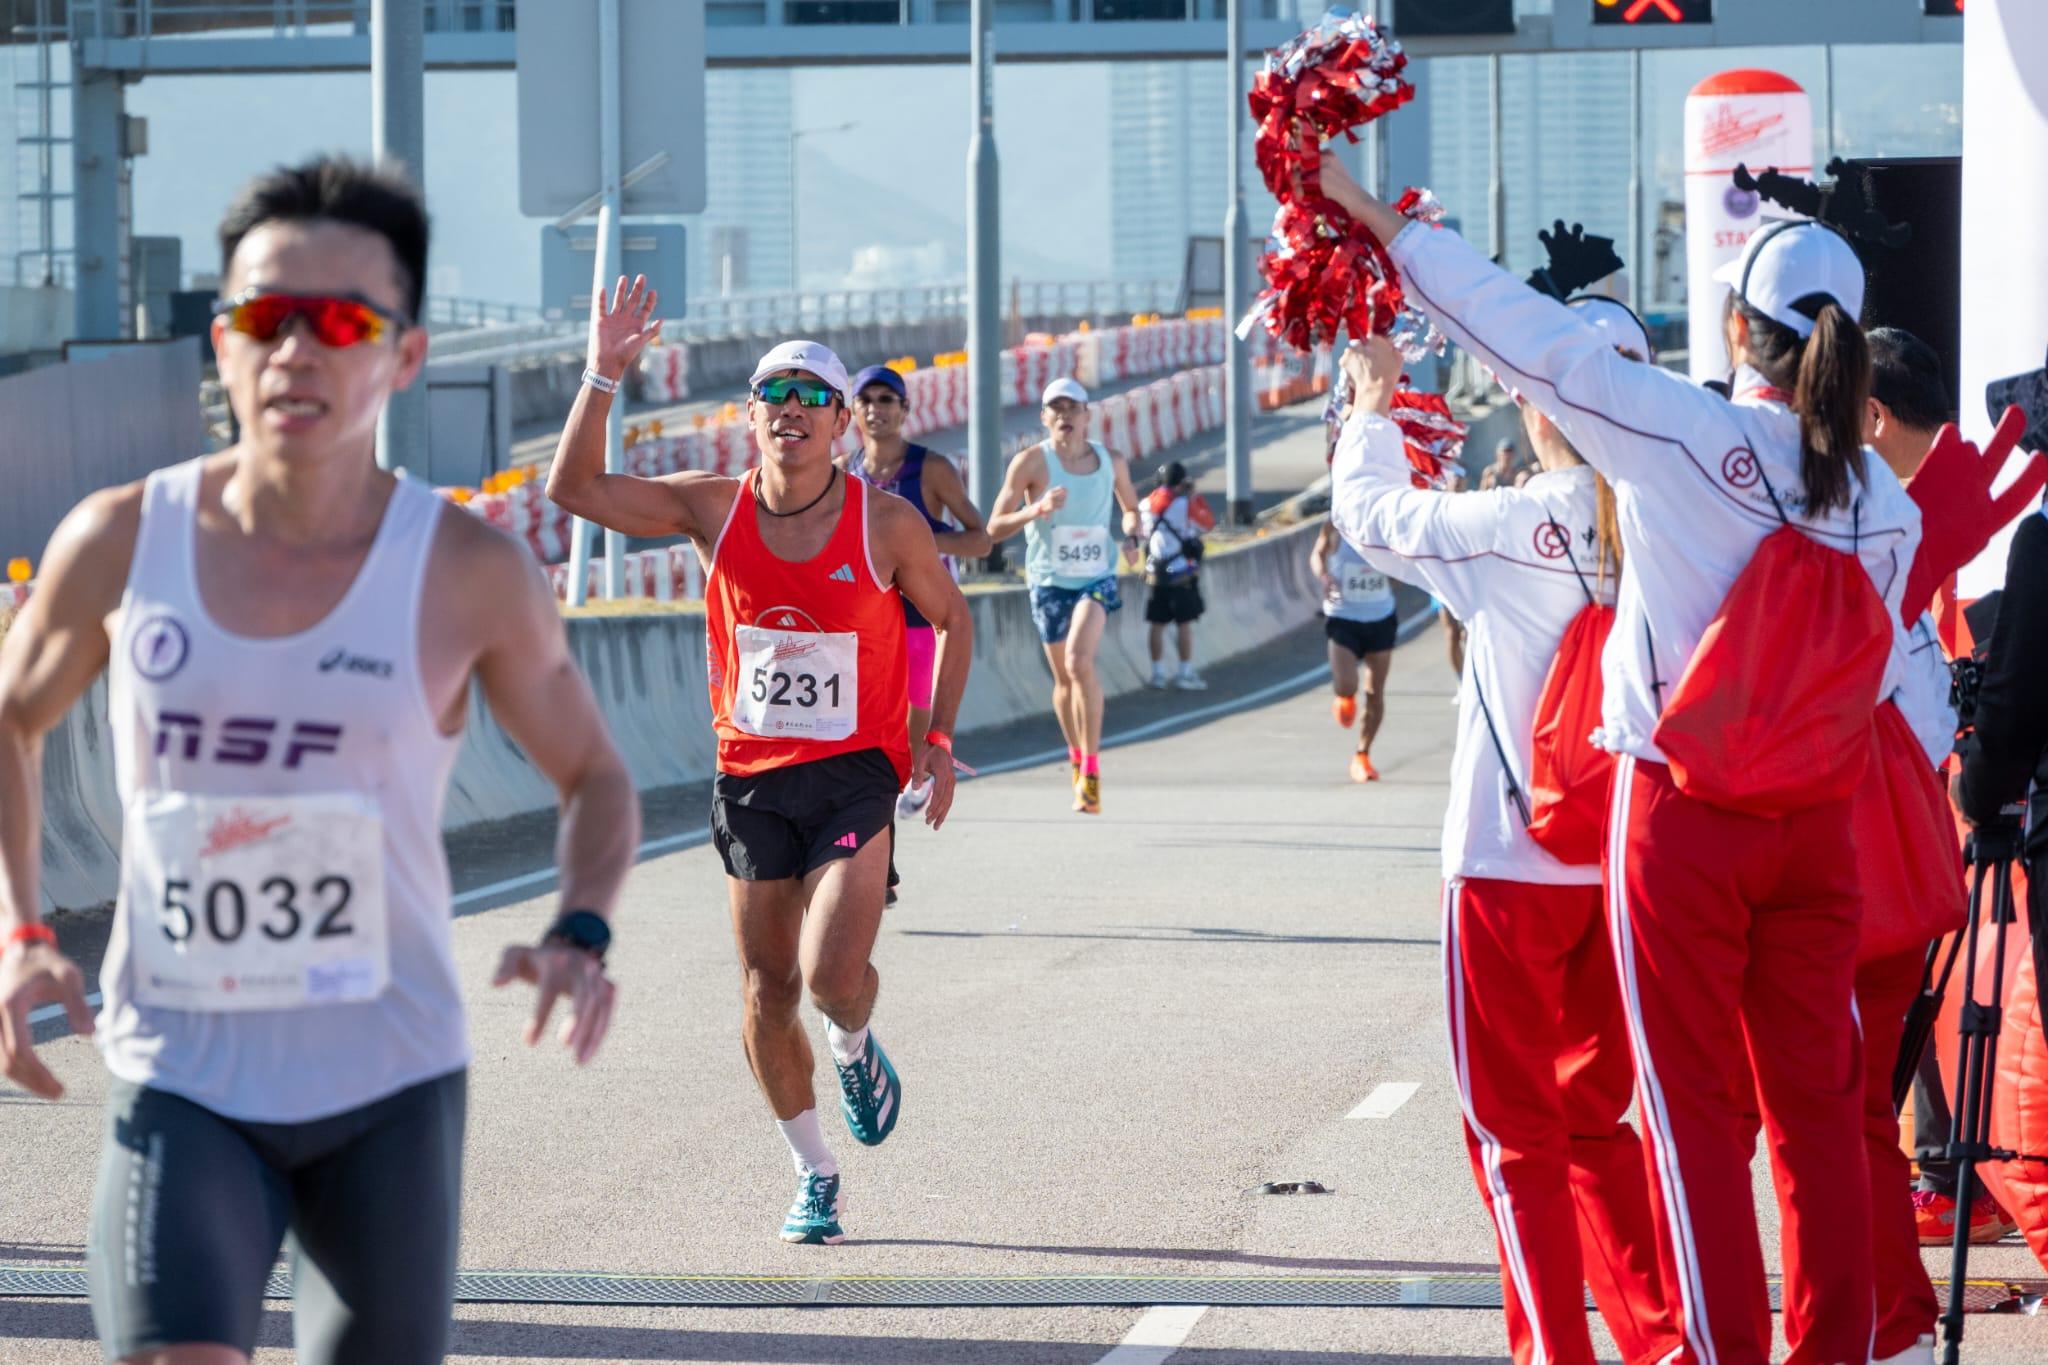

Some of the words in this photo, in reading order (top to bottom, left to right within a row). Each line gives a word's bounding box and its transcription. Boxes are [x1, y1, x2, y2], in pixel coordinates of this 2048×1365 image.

[1714, 229, 1757, 248] STA
[751, 667, 841, 708] 5231
[161, 874, 355, 944] 5032
